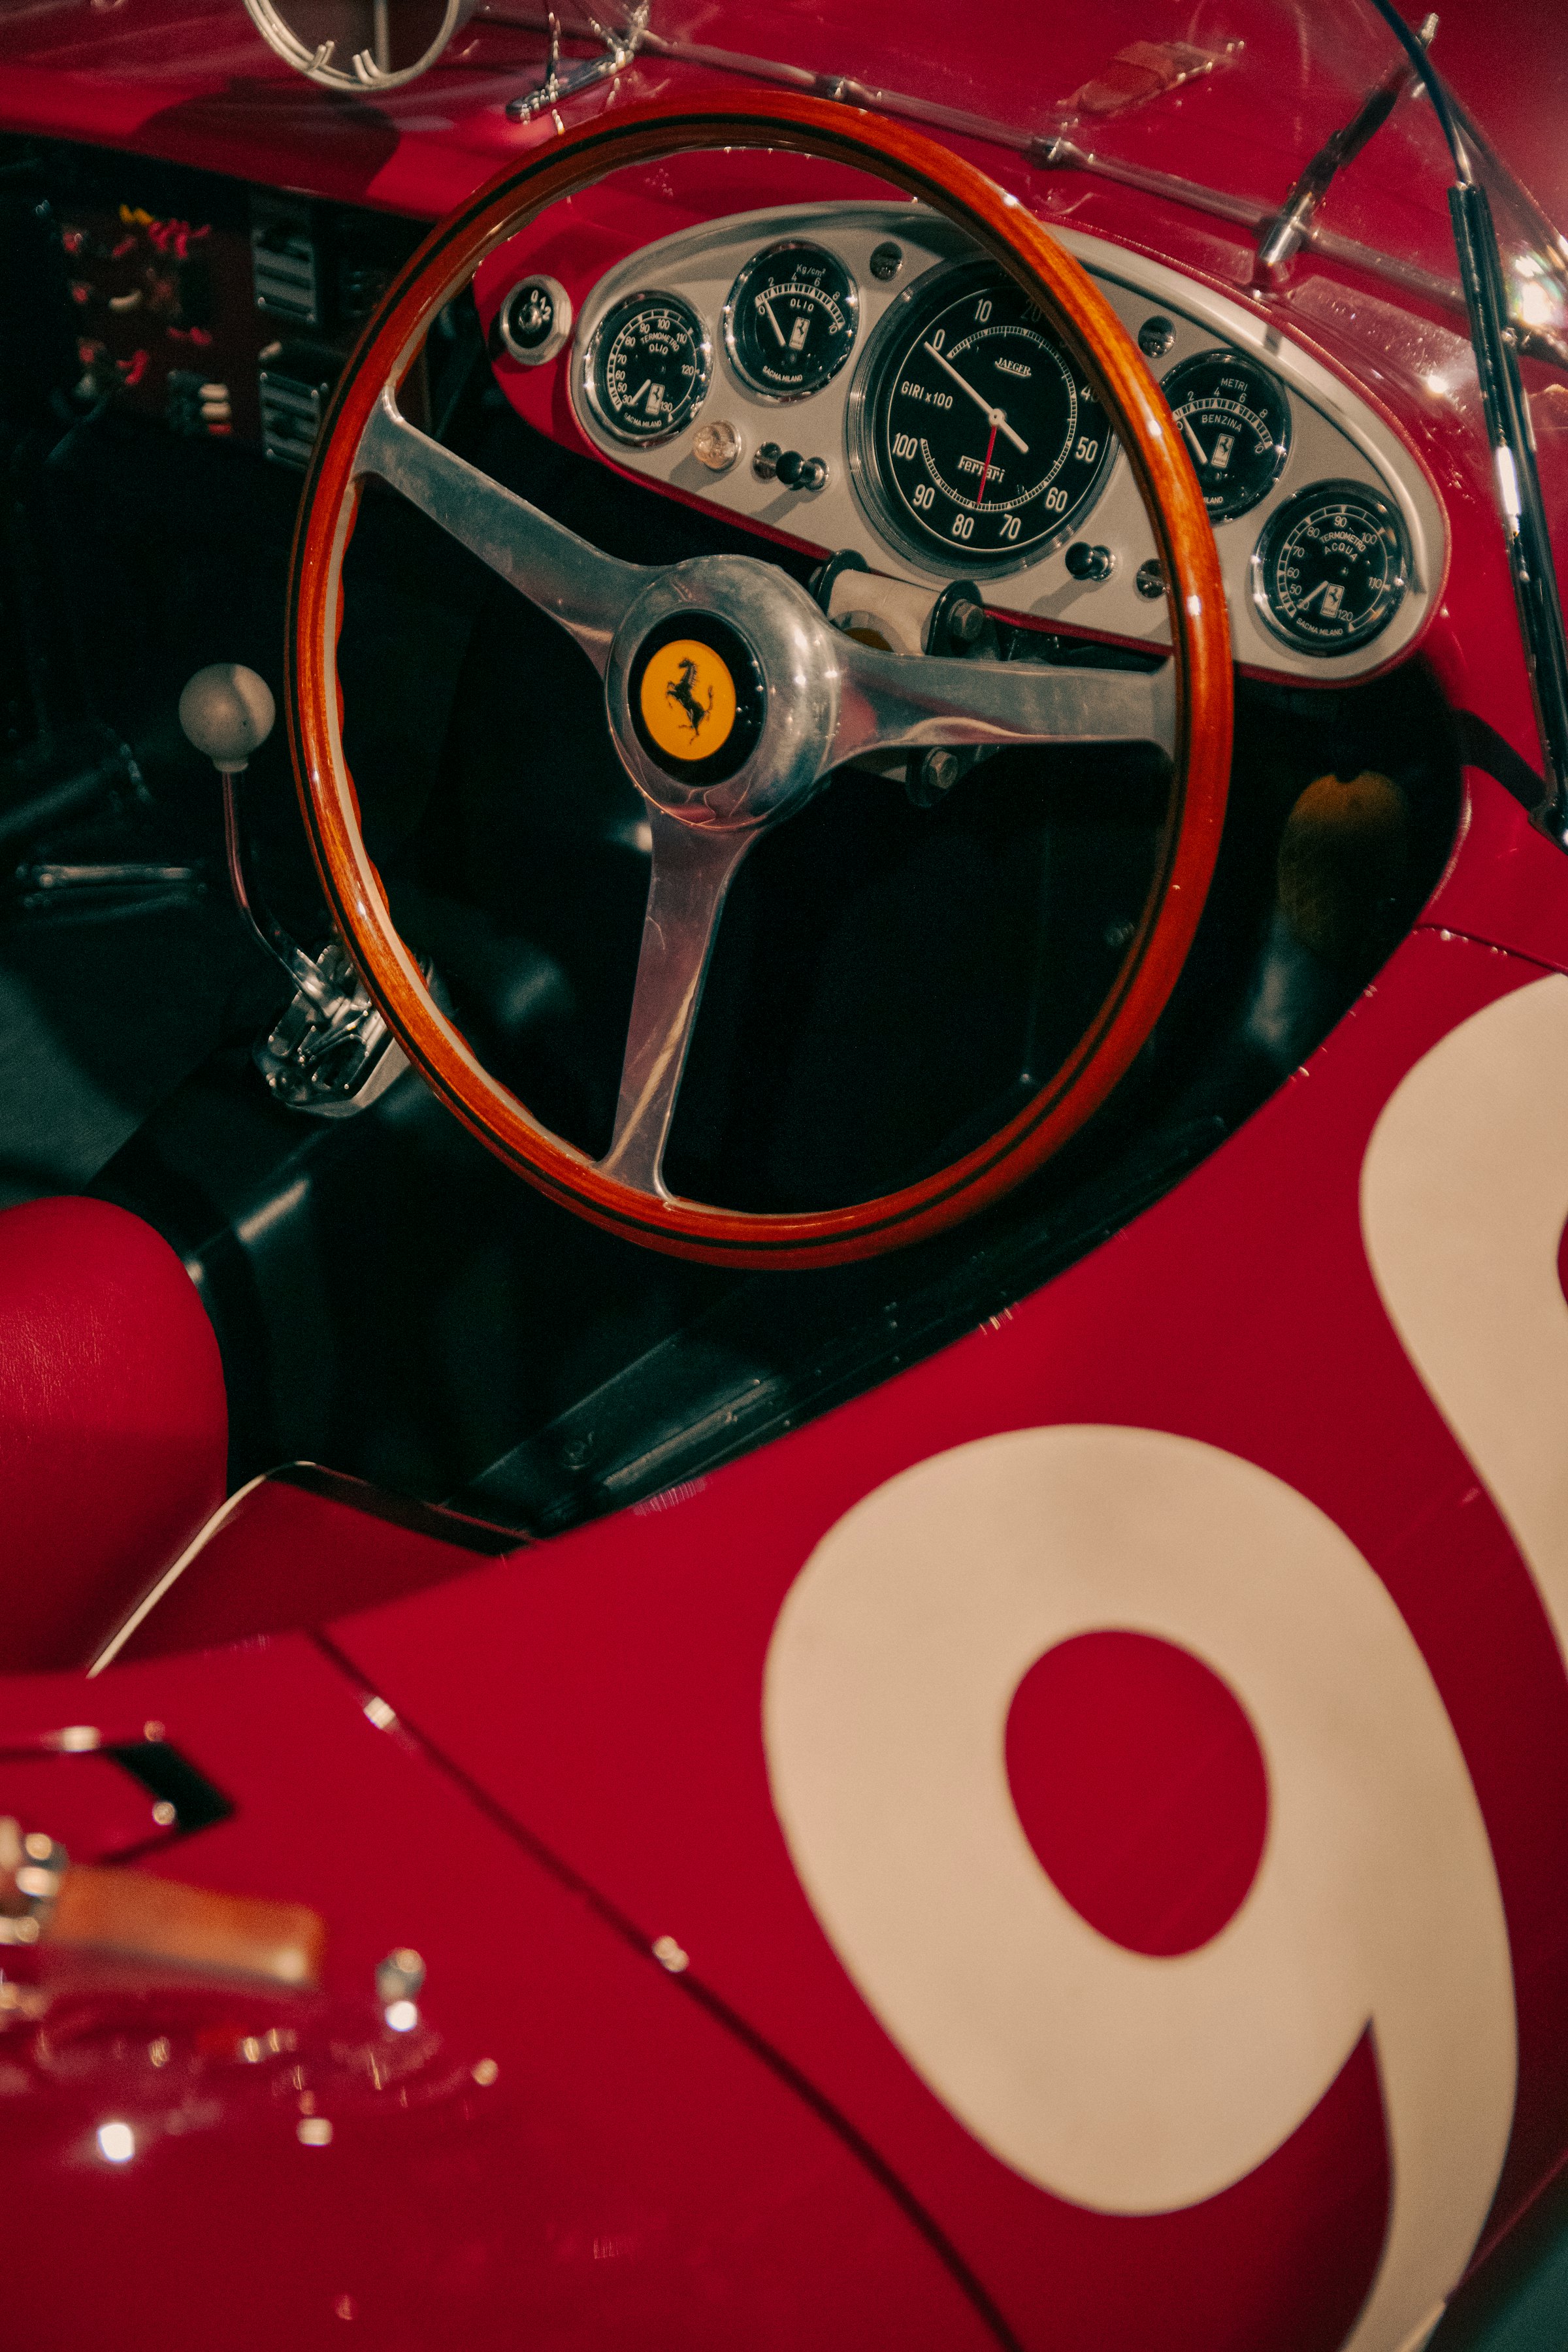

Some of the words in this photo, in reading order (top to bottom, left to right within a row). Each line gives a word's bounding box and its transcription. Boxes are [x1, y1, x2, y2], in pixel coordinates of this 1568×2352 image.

[768, 277, 775, 287] 2
[791, 272, 798, 282] 4
[814, 277, 821, 287] 6
[531, 290, 538, 302] 0
[832, 291, 841, 301] 8
[540, 297, 546, 309] 1
[790, 298, 814, 312] OLIO
[542, 306, 551, 320] 2
[758, 305, 766, 316] 0
[974, 299, 992, 323] 10
[640, 323, 651, 334] 90
[657, 318, 671, 331] 100
[625, 336, 636, 348] 80
[640, 332, 680, 352] TERMOMETRO
[676, 333, 688, 345] 110
[933, 329, 946, 351] 0
[649, 343, 669, 355] OLIO
[617, 353, 627, 365] 70
[615, 370, 626, 380] 60
[681, 364, 694, 376] 120
[782, 374, 803, 383] MILANO
[1220, 378, 1248, 391] METRI
[617, 382, 627, 393] 50
[1214, 387, 1220, 397] 4
[901, 381, 924, 400] GIRI
[925, 392, 953, 409] x100
[1188, 391, 1194, 401] 2
[1239, 393, 1247, 402] 6
[660, 401, 673, 412] 130
[1259, 409, 1268, 418] 8
[642, 419, 662, 429] MILANO
[1177, 421, 1183, 431] 0
[1201, 414, 1242, 433] BENZINA
[892, 433, 918, 460] 100
[1075, 436, 1098, 463] 50
[957, 455, 1006, 483] Ferrari
[913, 485, 936, 510] 90
[1046, 487, 1068, 512] 60
[952, 514, 975, 540] 80
[1000, 514, 1022, 541] 70
[1334, 515, 1347, 528] 90
[1307, 526, 1320, 538] 80
[1362, 532, 1378, 544] 100
[1320, 531, 1366, 553] TERMOMETRO
[1293, 546, 1305, 558] 70
[1324, 542, 1358, 562] ACQUA
[1287, 566, 1299, 579] 60
[1369, 577, 1382, 589] 110
[1290, 584, 1302, 595] 50
[1338, 609, 1354, 623] 120
[1296, 617, 1318, 634] SACMA
[1319, 628, 1343, 636] MILANO
